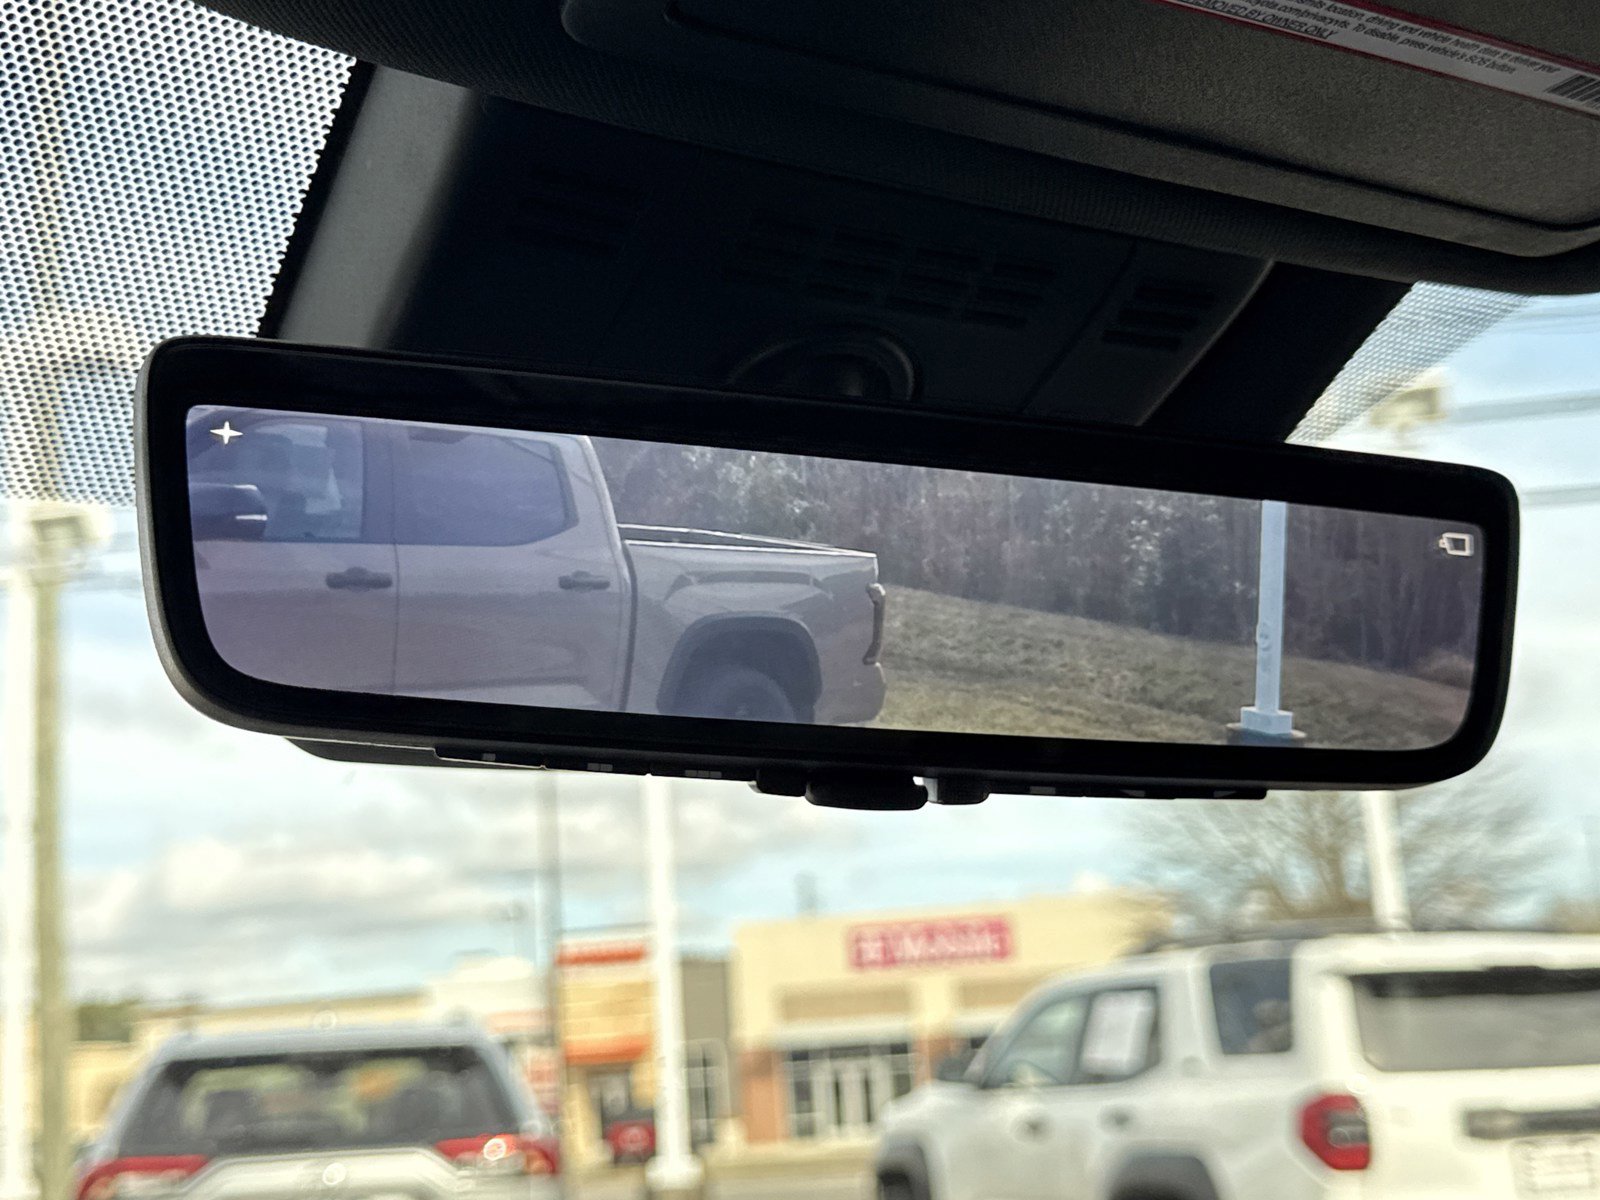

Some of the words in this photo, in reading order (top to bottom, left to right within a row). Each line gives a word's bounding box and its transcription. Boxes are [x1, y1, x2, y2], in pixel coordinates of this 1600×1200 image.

[1258, 13, 1308, 32] OWNER
[1303, 24, 1340, 40] ONLY
[1365, 16, 1400, 31] driving
[1397, 25, 1422, 35] and
[1418, 30, 1453, 44] vehicle
[1448, 39, 1481, 51] health
[1477, 47, 1501, 57] data
[1498, 52, 1513, 60] to
[1507, 56, 1542, 68] deliver
[1531, 63, 1562, 74] your
[1396, 38, 1429, 51] press
[1464, 54, 1491, 67] SOS
